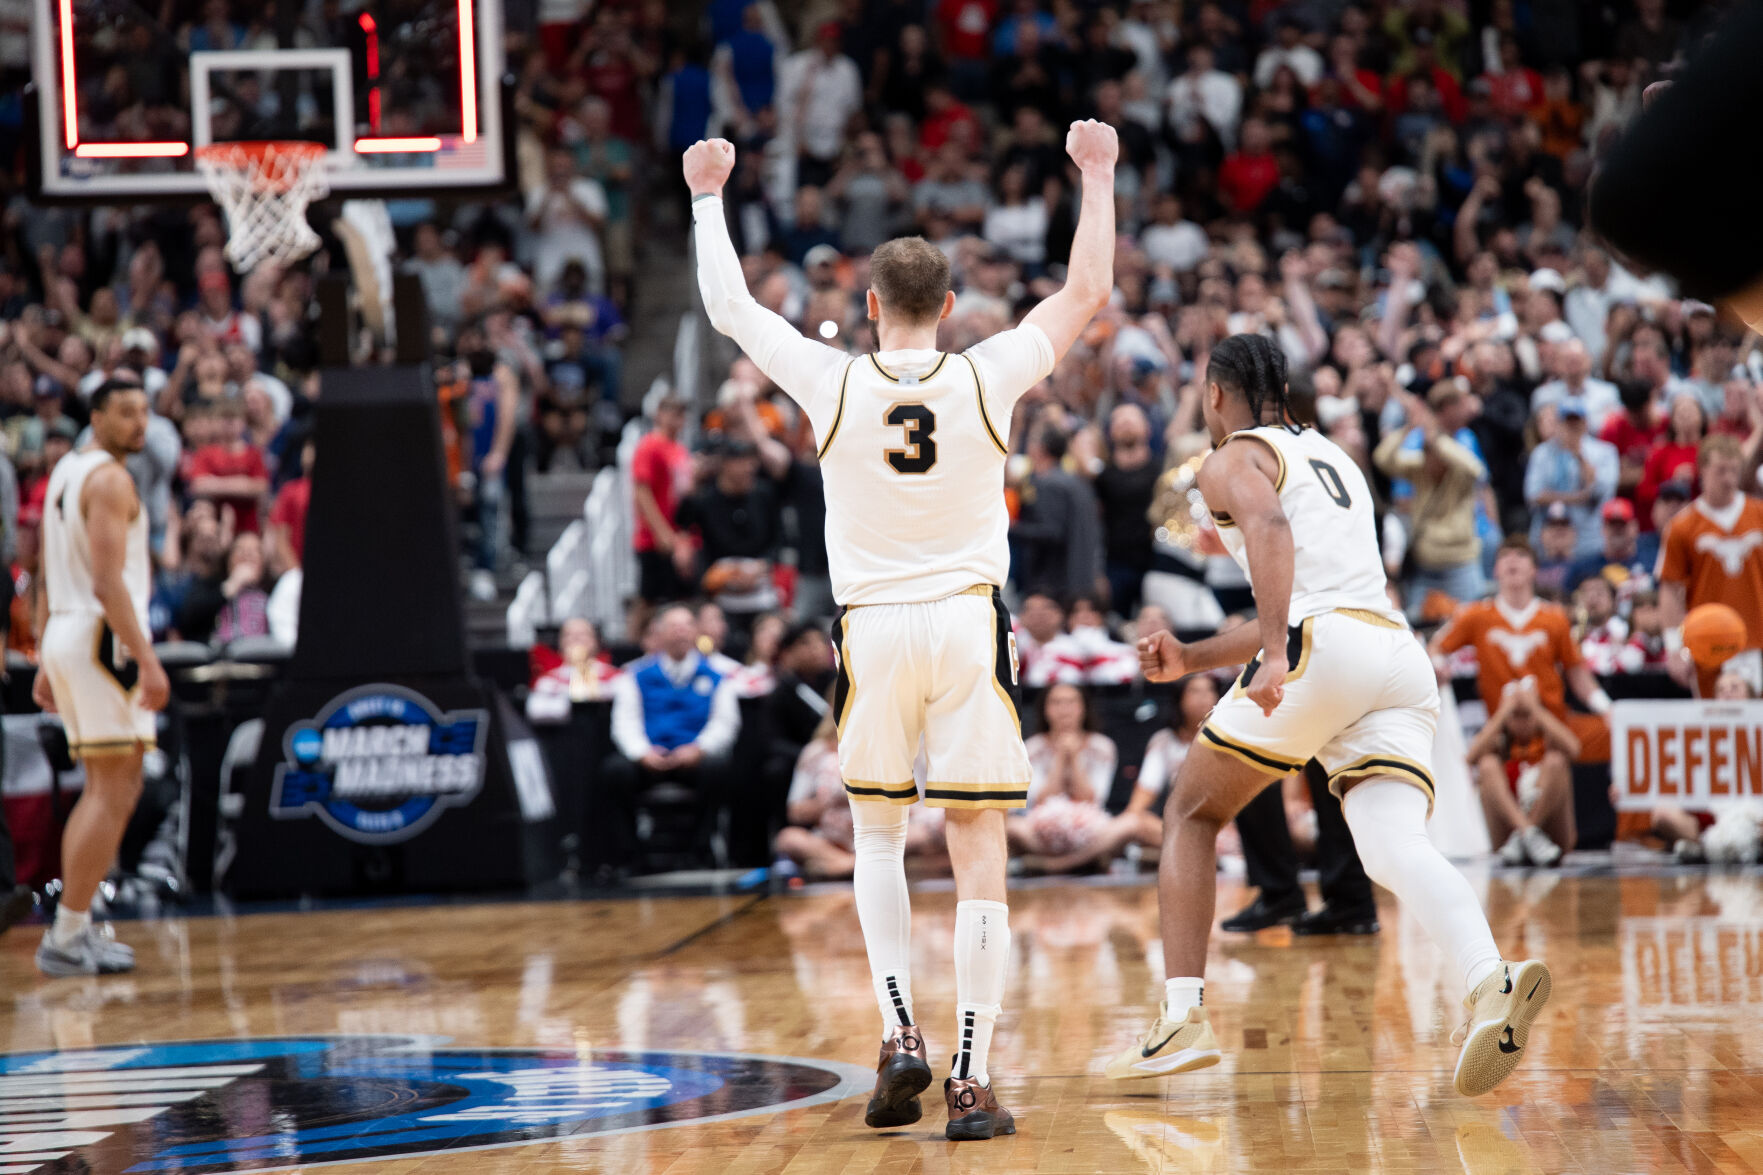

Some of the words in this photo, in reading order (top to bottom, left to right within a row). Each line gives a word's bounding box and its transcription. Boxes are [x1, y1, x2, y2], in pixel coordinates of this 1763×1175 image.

[882, 400, 938, 475] 3
[1305, 456, 1352, 509] 0
[321, 723, 432, 761] MARCH
